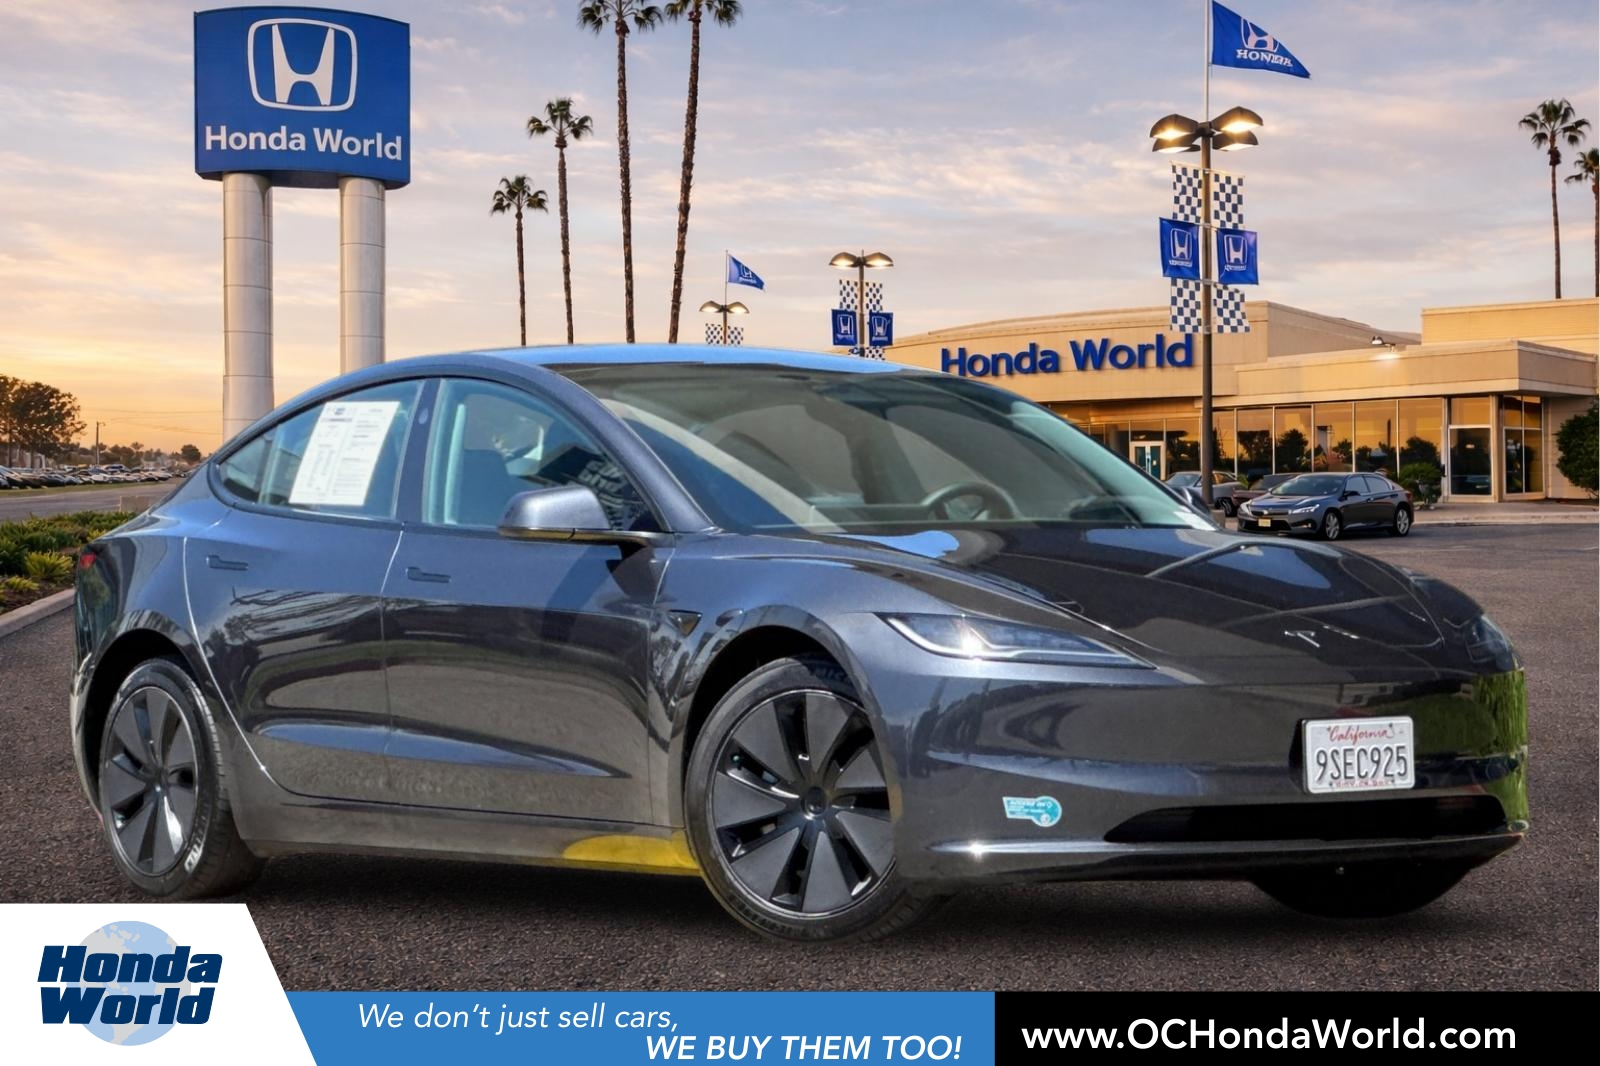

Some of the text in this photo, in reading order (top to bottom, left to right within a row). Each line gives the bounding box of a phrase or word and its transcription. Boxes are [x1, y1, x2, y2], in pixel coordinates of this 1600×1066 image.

[205, 125, 402, 161] Honda World
[941, 333, 1194, 377] Honda World
[1329, 725, 1395, 745] California
[1316, 744, 1408, 781] 9SEC925
